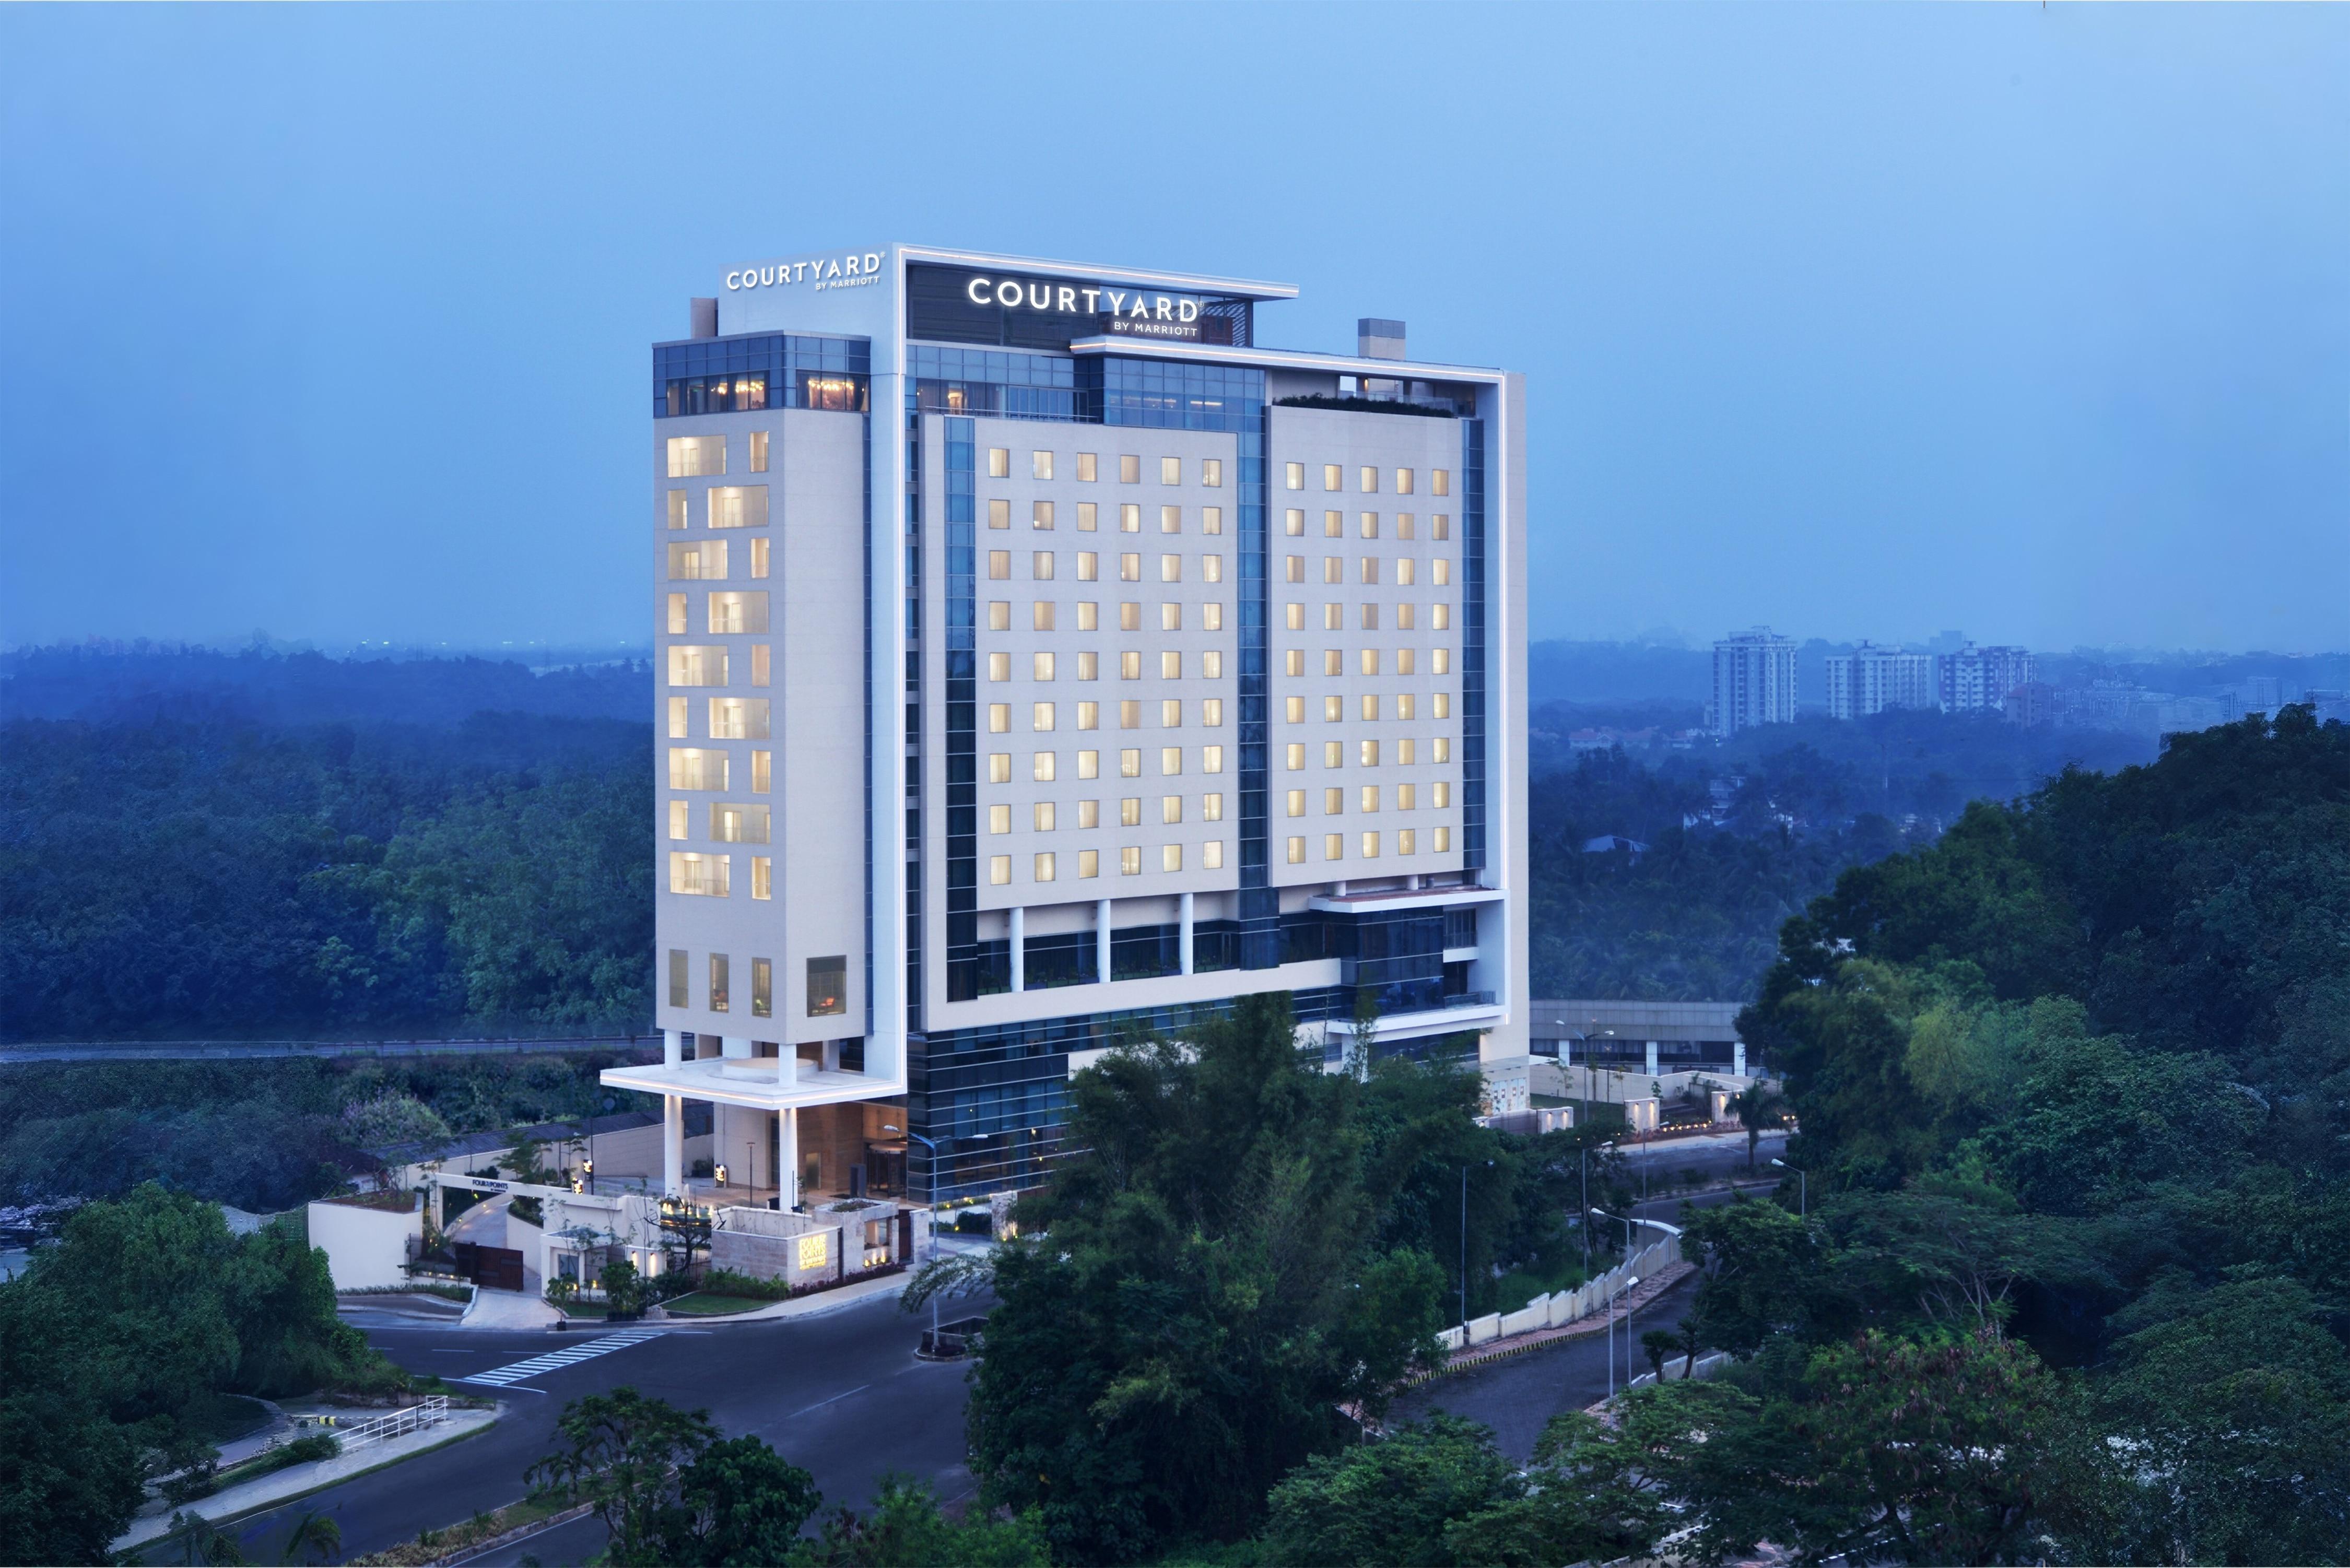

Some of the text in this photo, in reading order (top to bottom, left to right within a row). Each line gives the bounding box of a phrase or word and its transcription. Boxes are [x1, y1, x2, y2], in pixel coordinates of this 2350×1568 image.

[726, 253, 880, 290] COURTYARD
[816, 276, 879, 290] BY MARRIOTT
[968, 278, 1197, 322] COURTYARD
[1114, 321, 1197, 336] BY MARRIOTT
